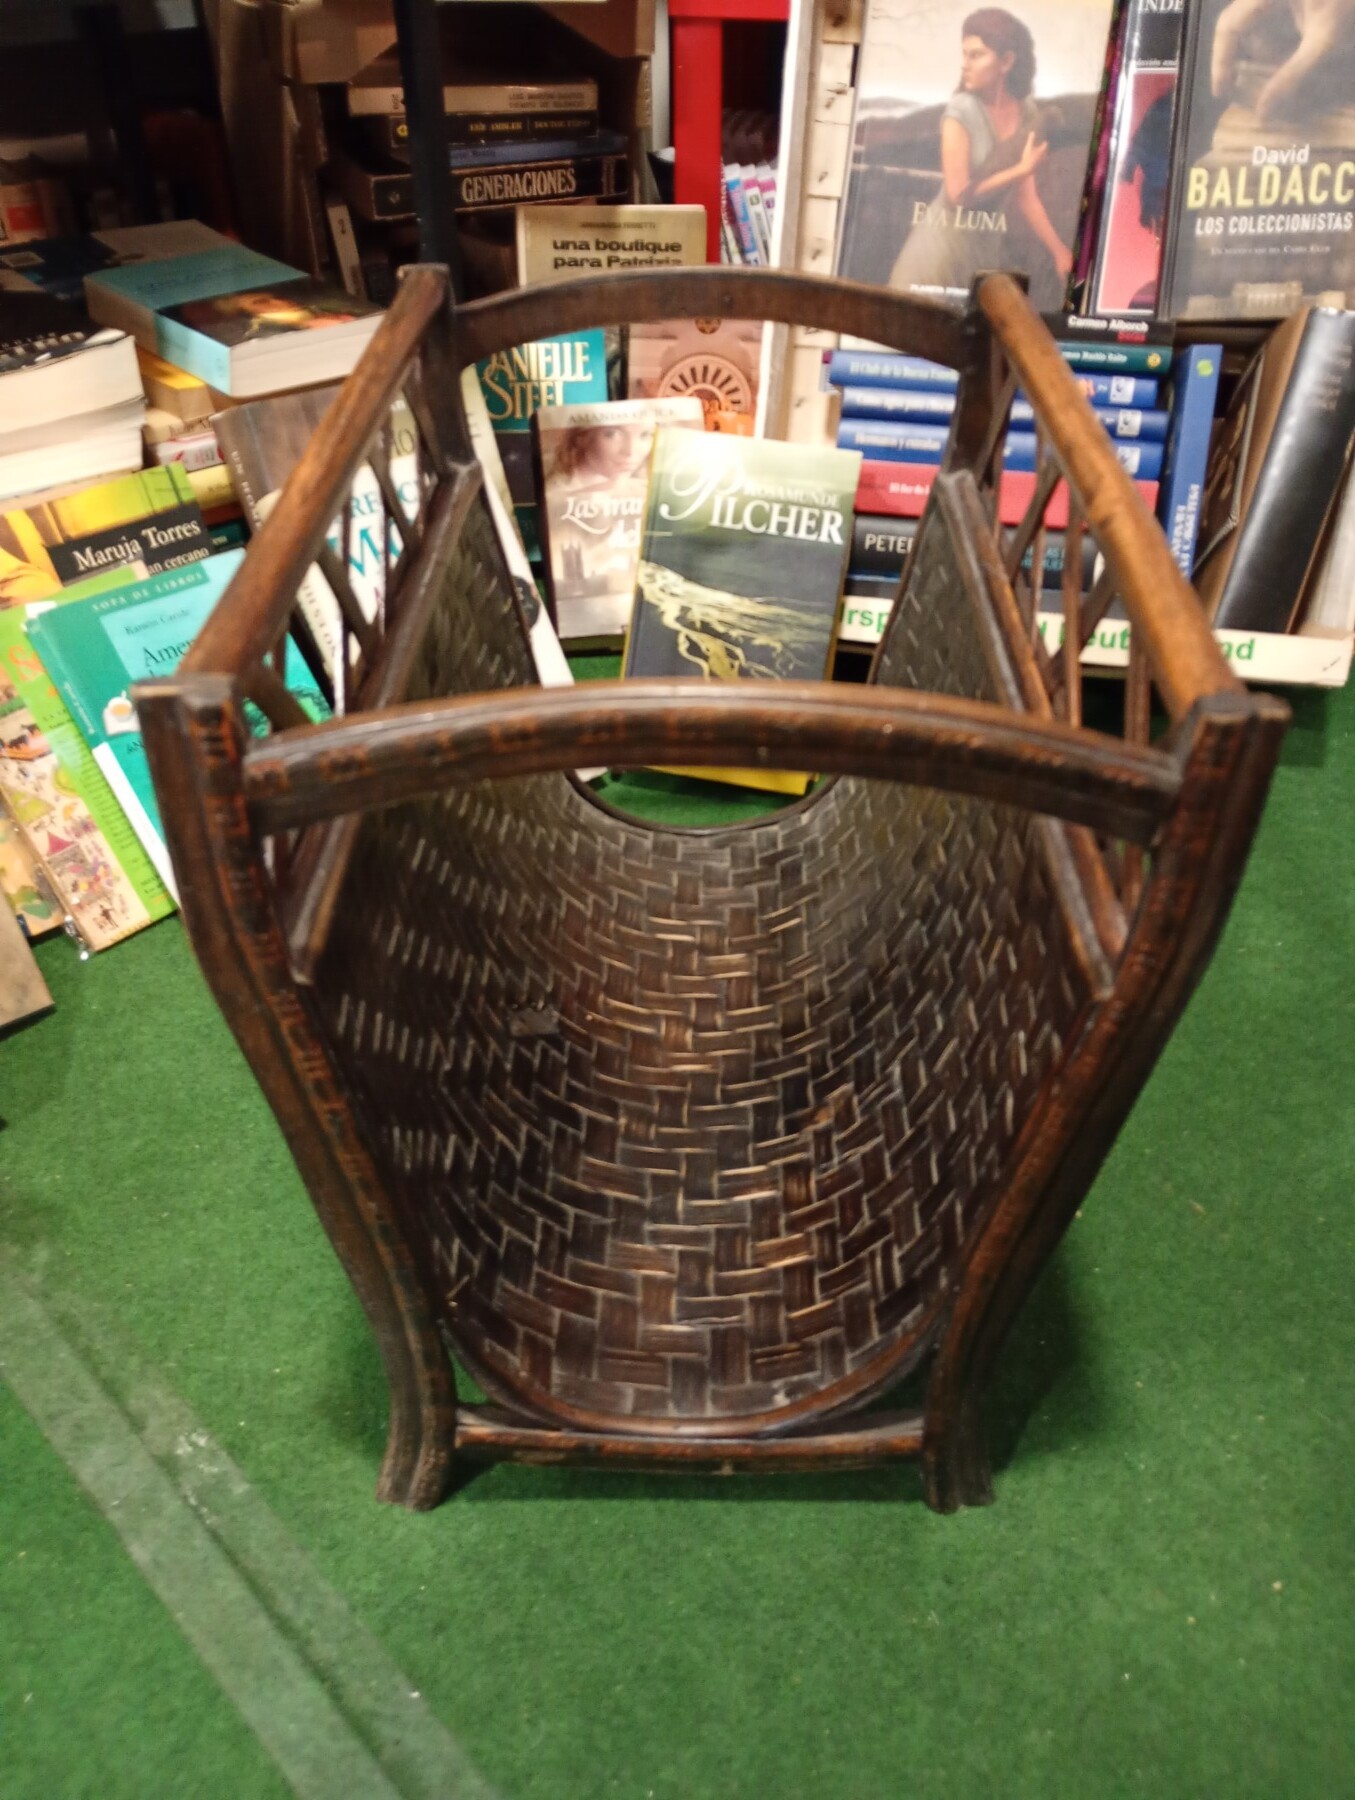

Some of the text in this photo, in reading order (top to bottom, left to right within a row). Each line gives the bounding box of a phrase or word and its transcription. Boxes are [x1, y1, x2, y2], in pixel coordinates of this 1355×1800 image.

[1252, 144, 1311, 166] David
[461, 167, 577, 203] GENERACIONES
[954, 204, 1008, 232] LUNA
[1195, 211, 1354, 237] LOS COLECCIONISTAS
[552, 238, 683, 254] una boutique
[553, 255, 602, 269] para
[1067, 315, 1109, 329] Carmen
[72, 520, 201, 571] Maruja Torres
[163, 547, 210, 570] cercano
[92, 572, 204, 613] SOPA DE LIBROS
